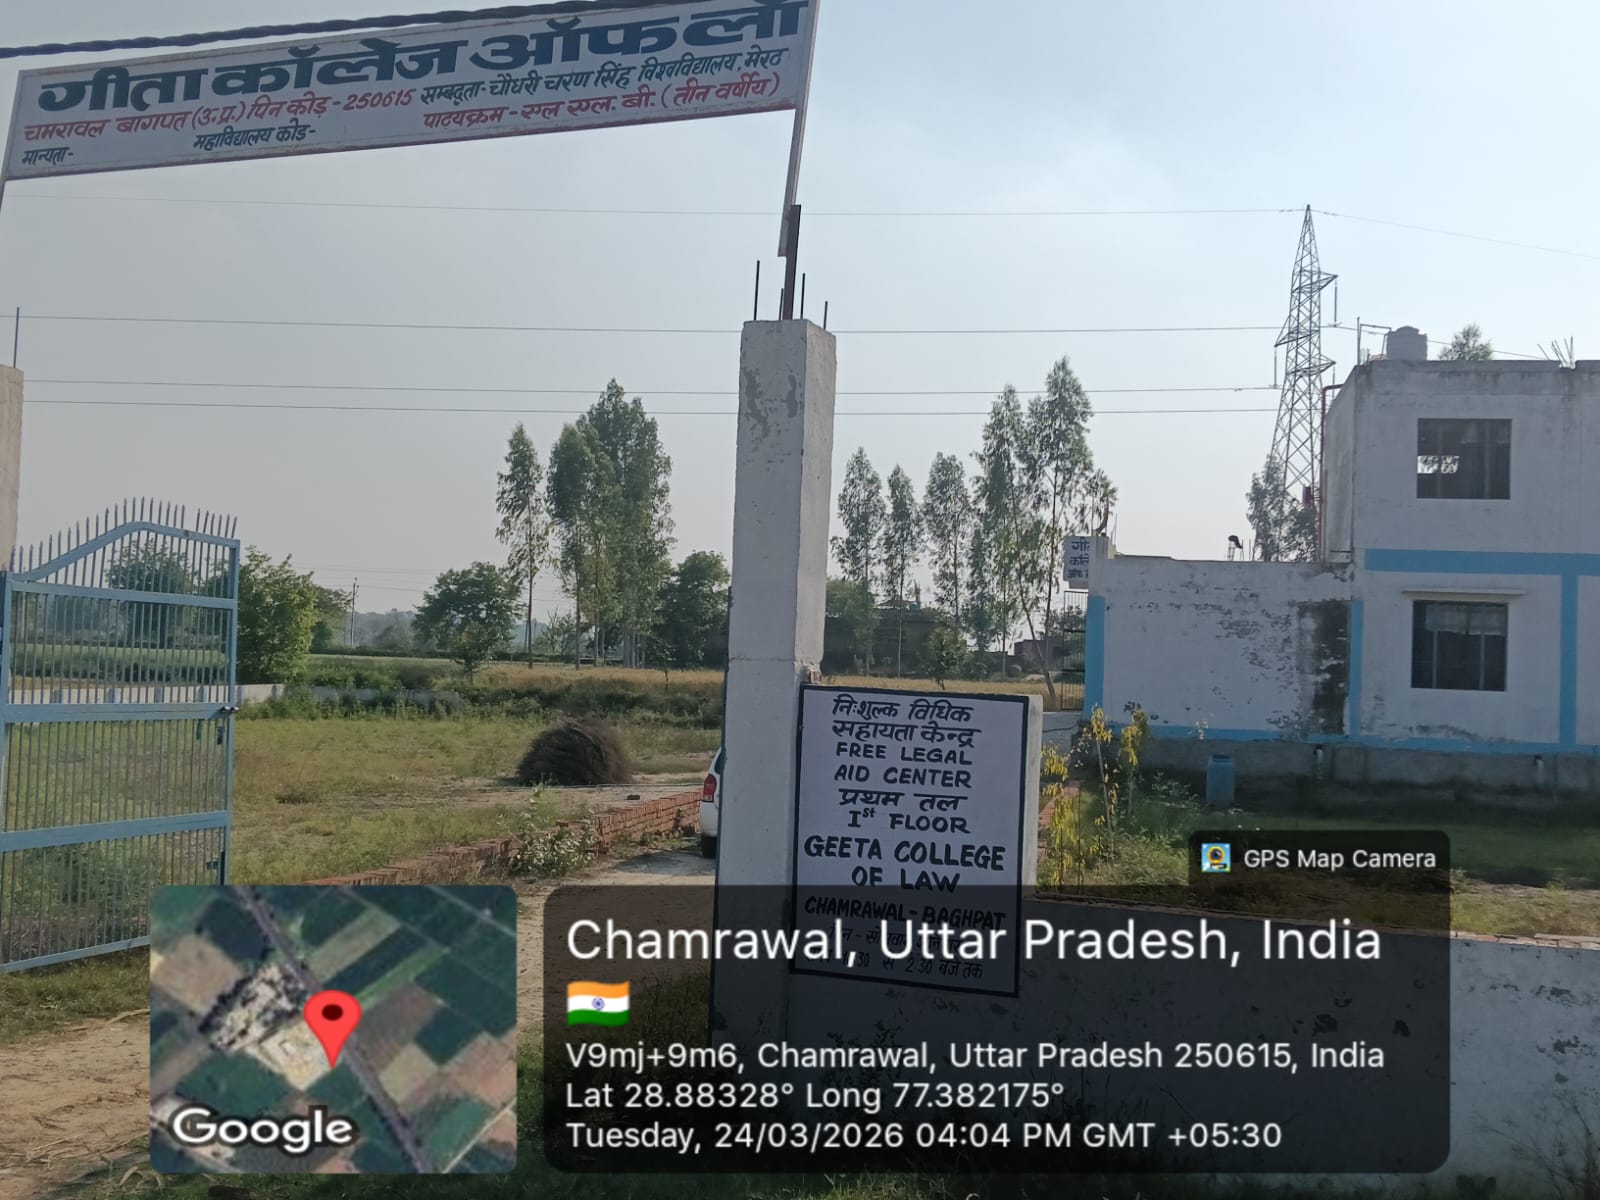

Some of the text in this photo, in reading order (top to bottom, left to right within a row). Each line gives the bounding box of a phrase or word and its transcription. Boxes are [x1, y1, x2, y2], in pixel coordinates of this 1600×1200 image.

[38, 66, 208, 112] गीता
[211, 37, 468, 98] कॉलेज
[469, 16, 679, 70] ऑफ
[544, 69, 594, 94] चरण
[594, 60, 636, 89] सिंह
[744, 44, 789, 70] मेरठ
[24, 119, 110, 141] चमरावल
[116, 111, 192, 133] बागपत
[247, 94, 287, 120] पिन
[193, 126, 276, 152] महाविद्यालय
[832, 694, 974, 722] निःशुल्क विधिक
[832, 720, 981, 748] सहायता केन्द्र
[835, 741, 973, 765] FREE LEGAL
[834, 764, 972, 788] AID CENTER
[839, 788, 968, 811] प्रथम तल
[890, 813, 971, 834] FLOOR
[804, 835, 1006, 871] GEETA COLLEGE
[851, 866, 961, 893] OF LAW
[962, 961, 984, 979] तक
